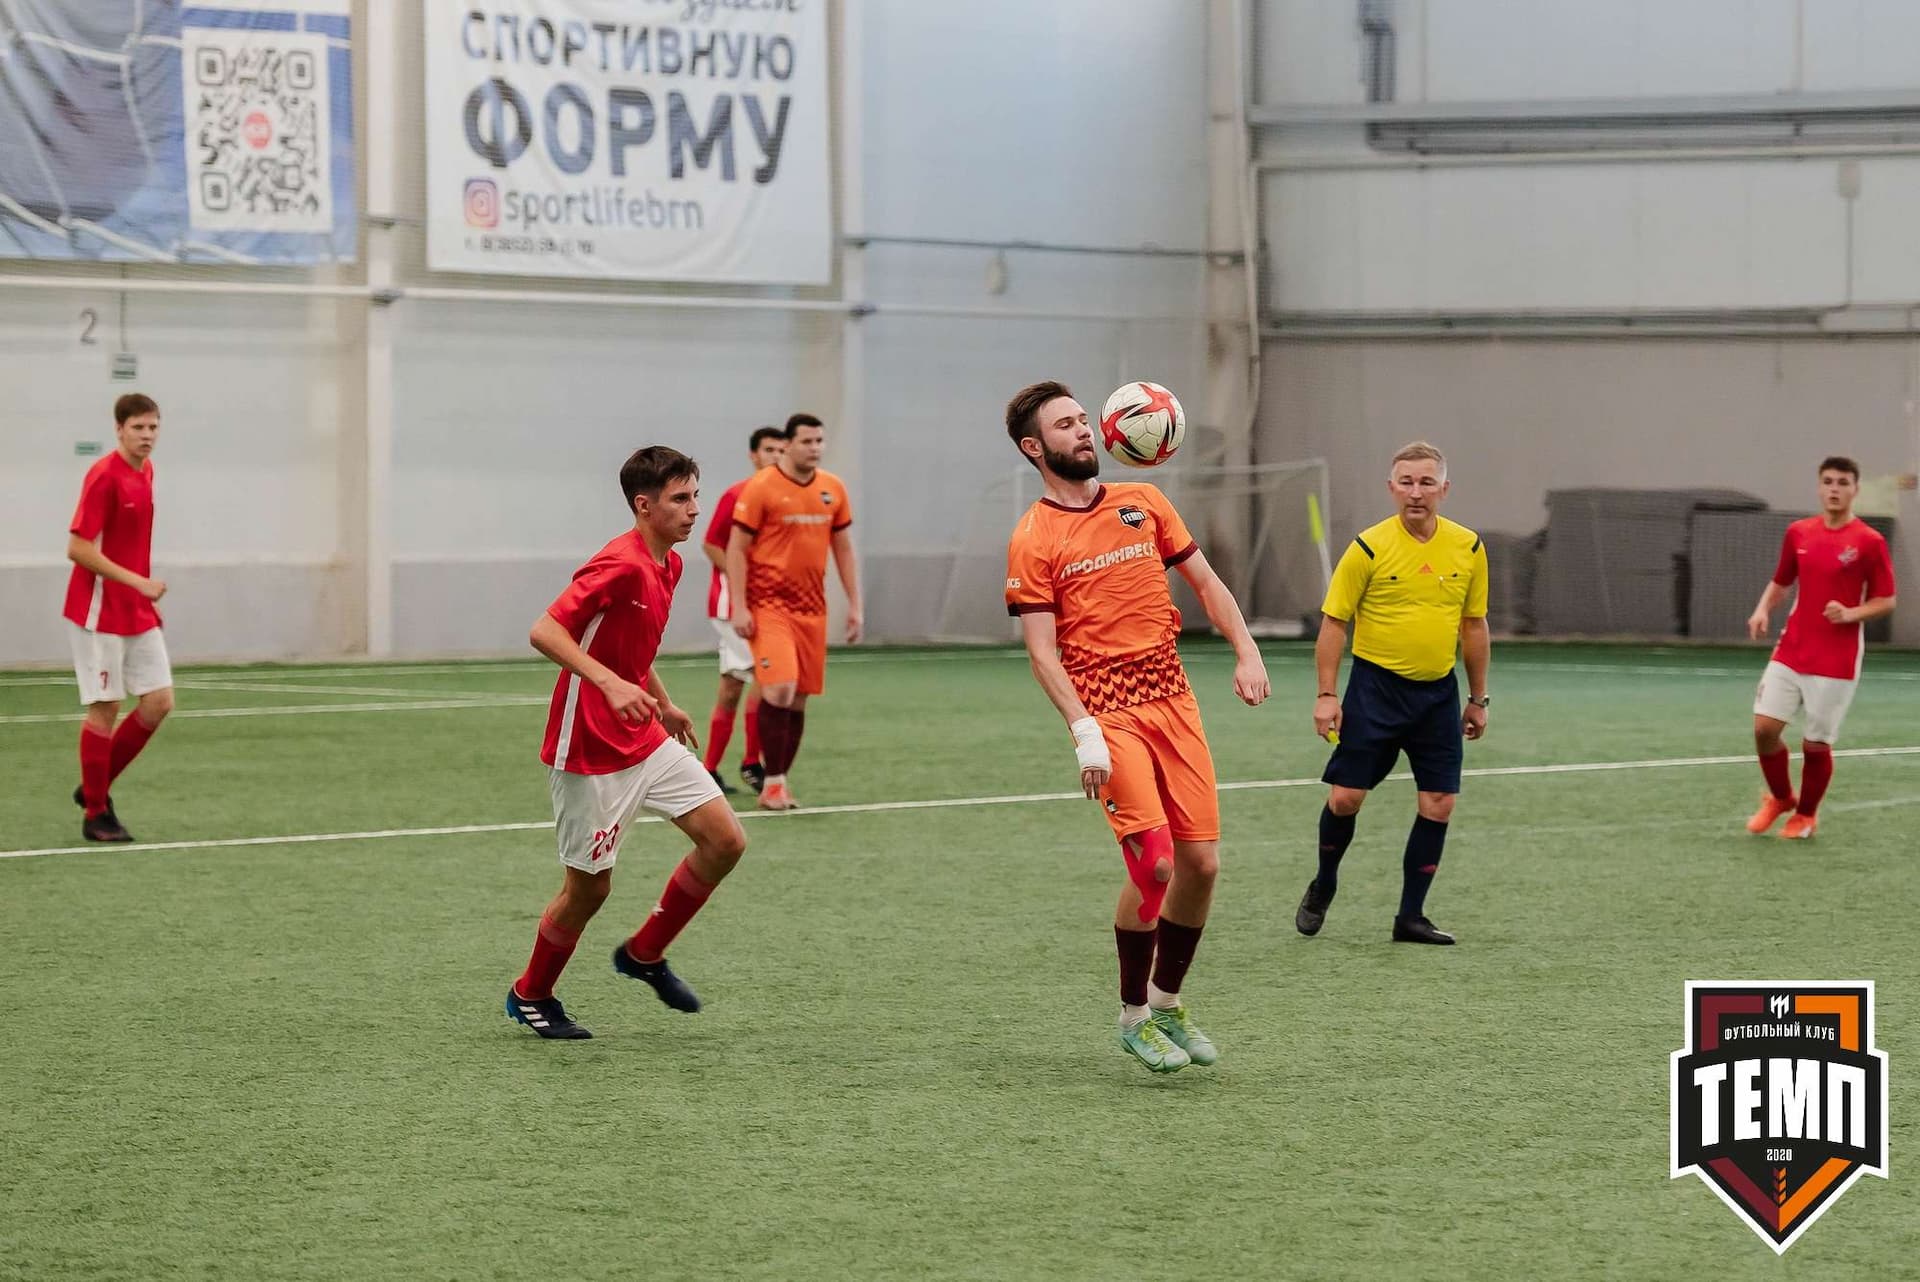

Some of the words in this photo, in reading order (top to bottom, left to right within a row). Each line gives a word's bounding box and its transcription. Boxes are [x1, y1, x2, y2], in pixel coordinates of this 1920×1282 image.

[462, 11, 795, 82] СПОРТИВНУЮ
[463, 77, 792, 185] ФОРМУ
[504, 187, 705, 230] sportlifebrn
[79, 308, 97, 345] 2
[99, 670, 109, 690] 7
[591, 823, 620, 861] 23
